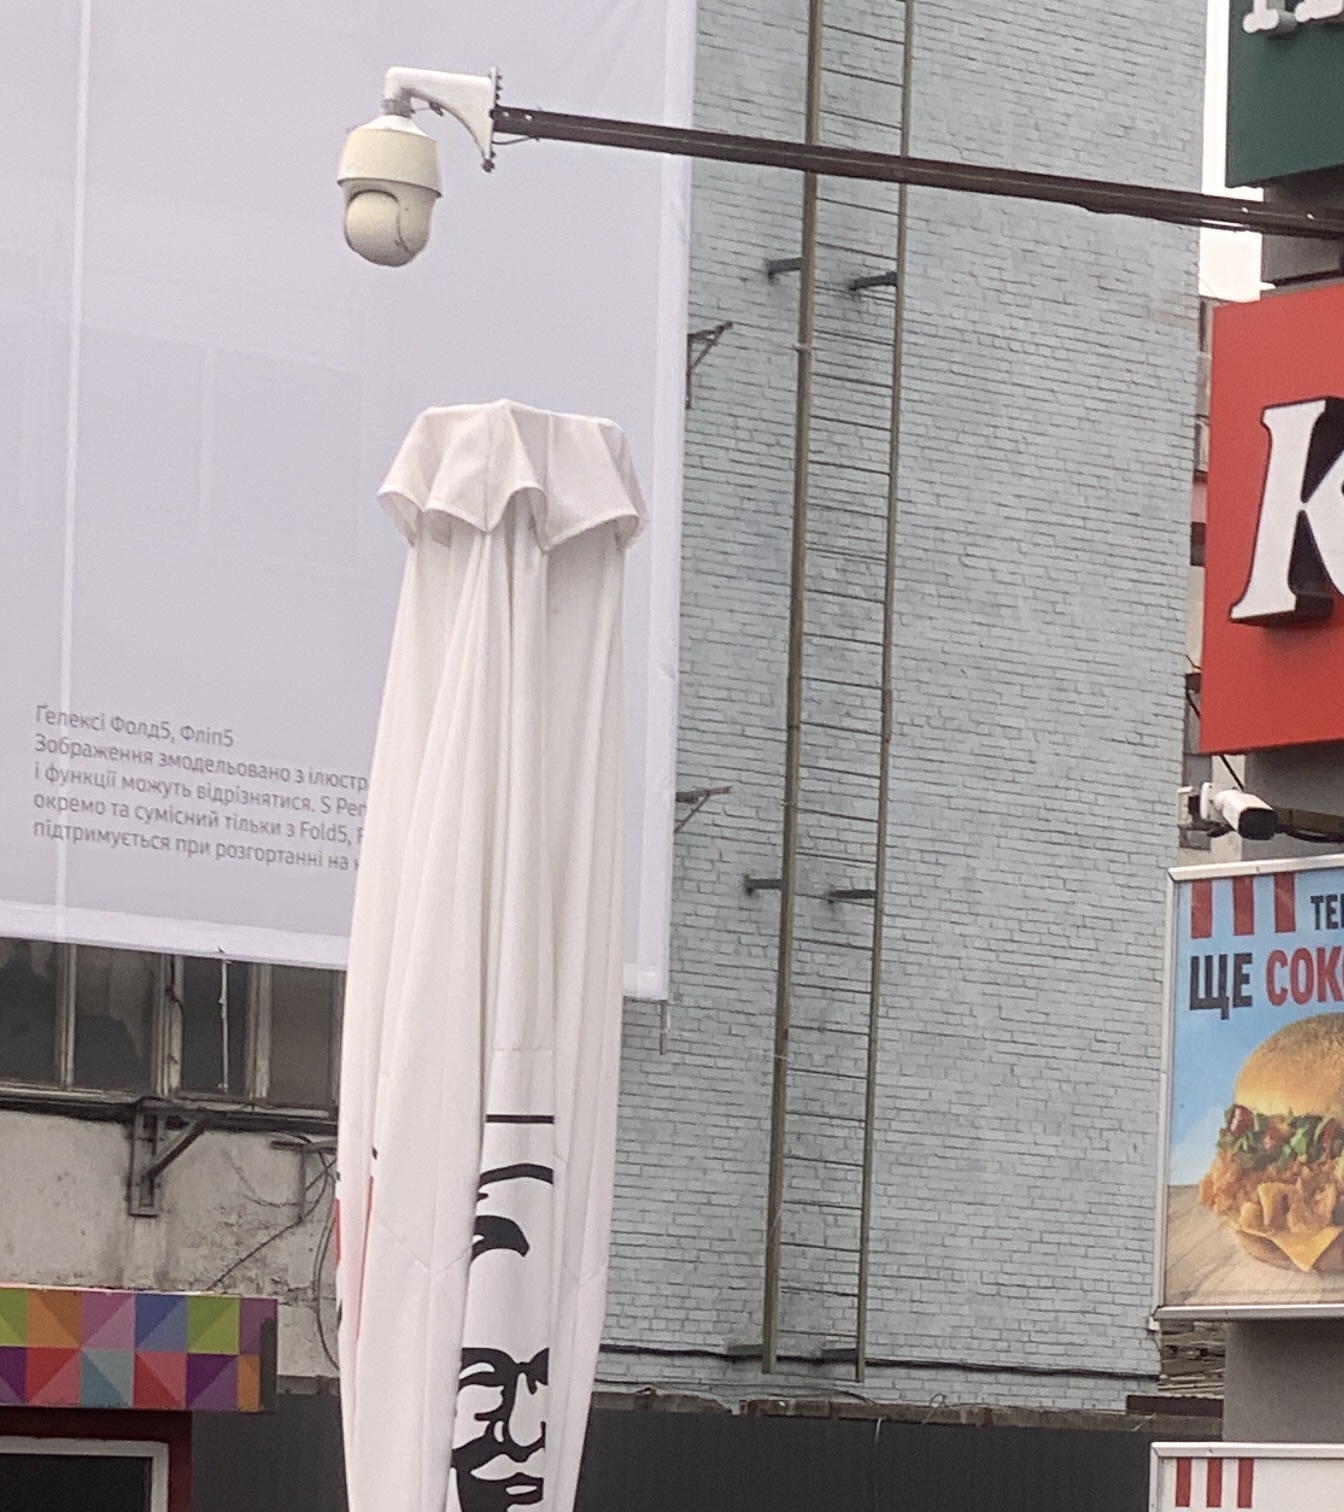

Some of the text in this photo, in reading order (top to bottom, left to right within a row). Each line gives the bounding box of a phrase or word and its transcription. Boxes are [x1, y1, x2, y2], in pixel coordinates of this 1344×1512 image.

[110, 716, 175, 744] Фолд5,
[180, 726, 235, 749] Фліп5
[34, 733, 153, 765] Зображення
[159, 753, 290, 782] змодельовано
[294, 769, 305, 784] з
[45, 764, 117, 790] функції
[121, 776, 192, 800] можуть
[197, 783, 317, 813] відрізнятися.
[320, 796, 332, 815] S
[33, 793, 107, 816] окремо
[111, 801, 131, 819] та
[134, 804, 220, 830] сумісний
[224, 814, 281, 837] тільки
[285, 822, 296, 839] з
[299, 821, 352, 847] Fold5,
[33, 819, 350, 871] підтримується при розгортанні на
[1190, 952, 1254, 1020] ЩЕ
